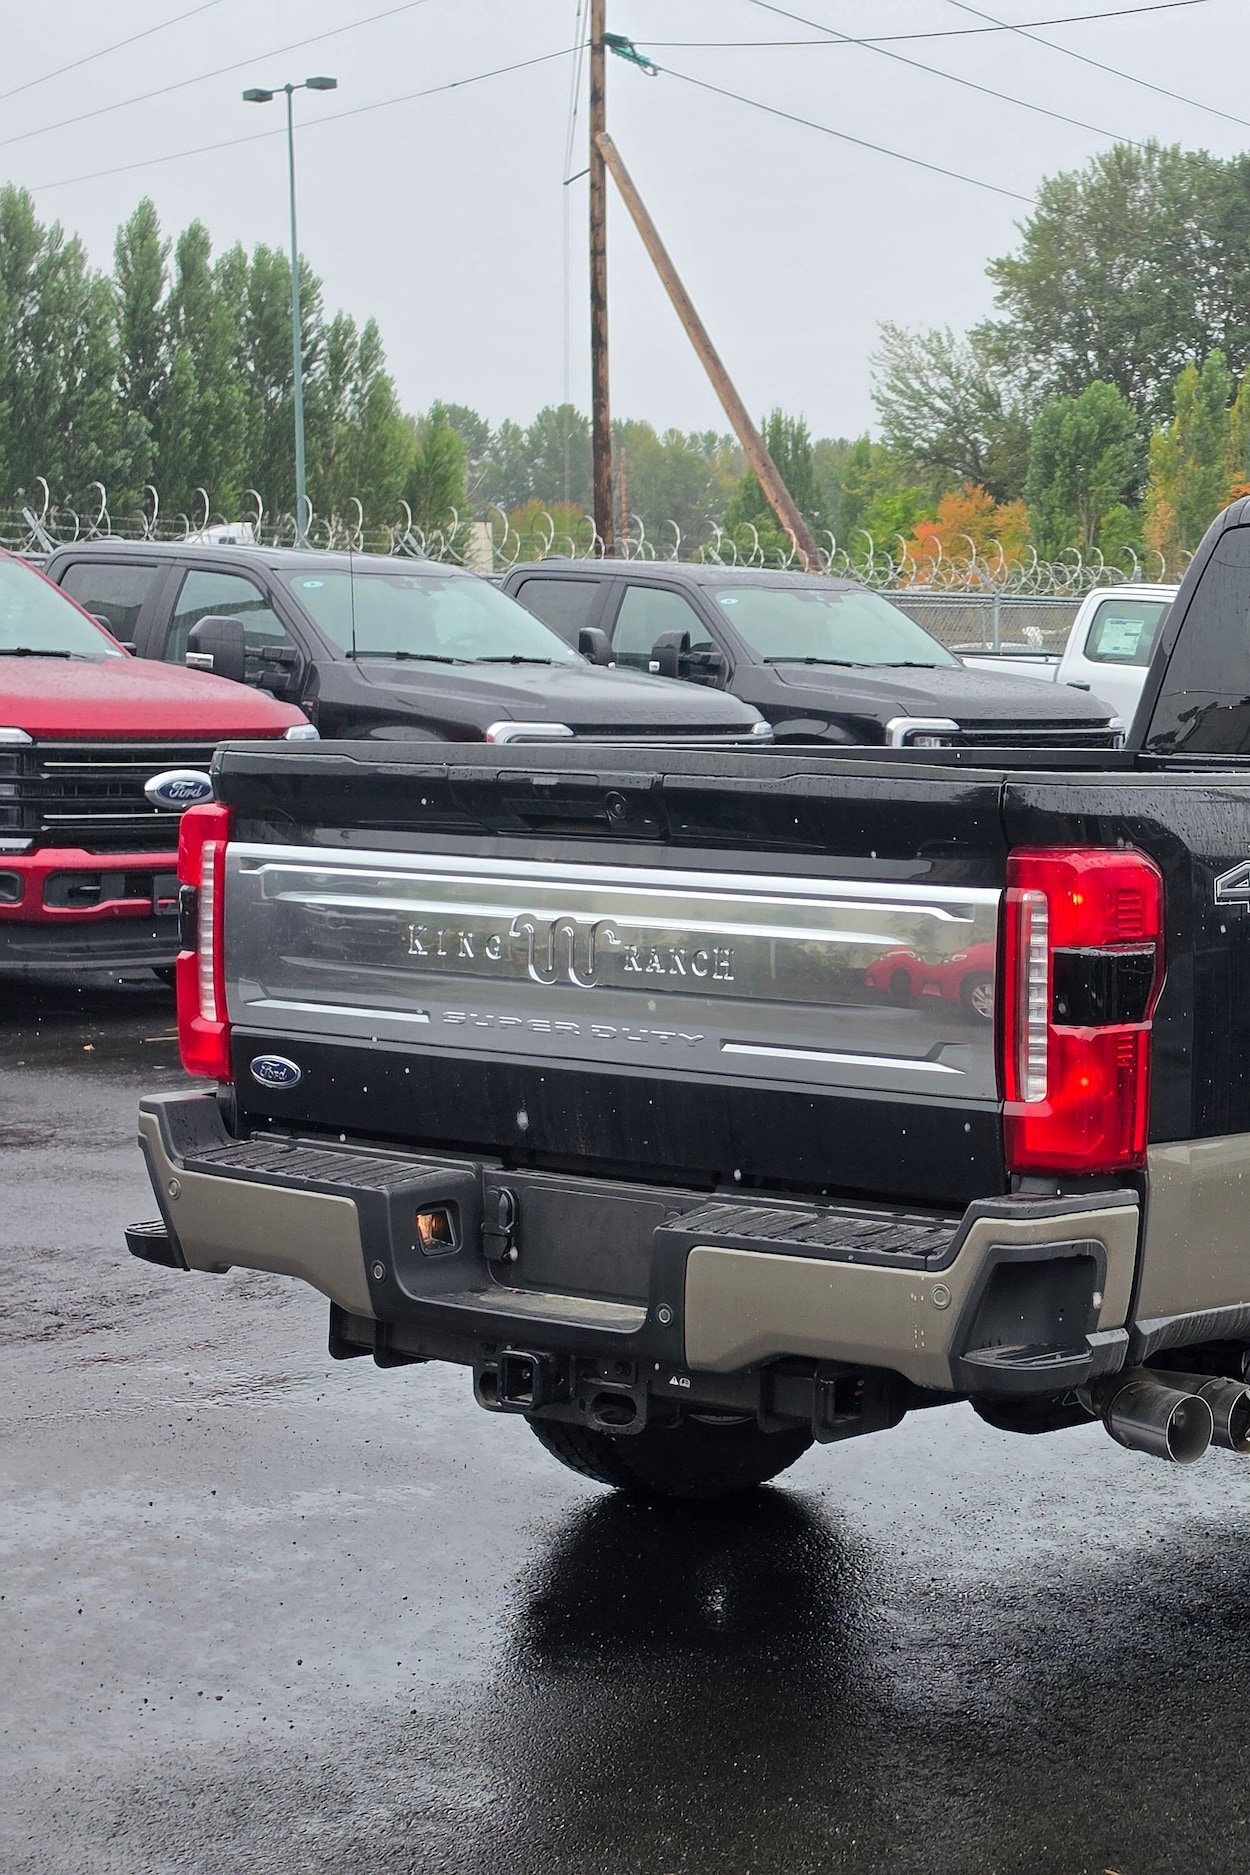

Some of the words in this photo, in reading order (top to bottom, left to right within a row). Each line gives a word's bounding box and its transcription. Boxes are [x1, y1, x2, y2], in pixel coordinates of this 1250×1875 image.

[168, 780, 203, 799] Ford
[407, 922, 503, 961] KING
[623, 943, 736, 981] RANCH
[442, 1010, 582, 1037] SUPER
[590, 1024, 706, 1048] DUTY
[259, 1060, 288, 1081] Ford
